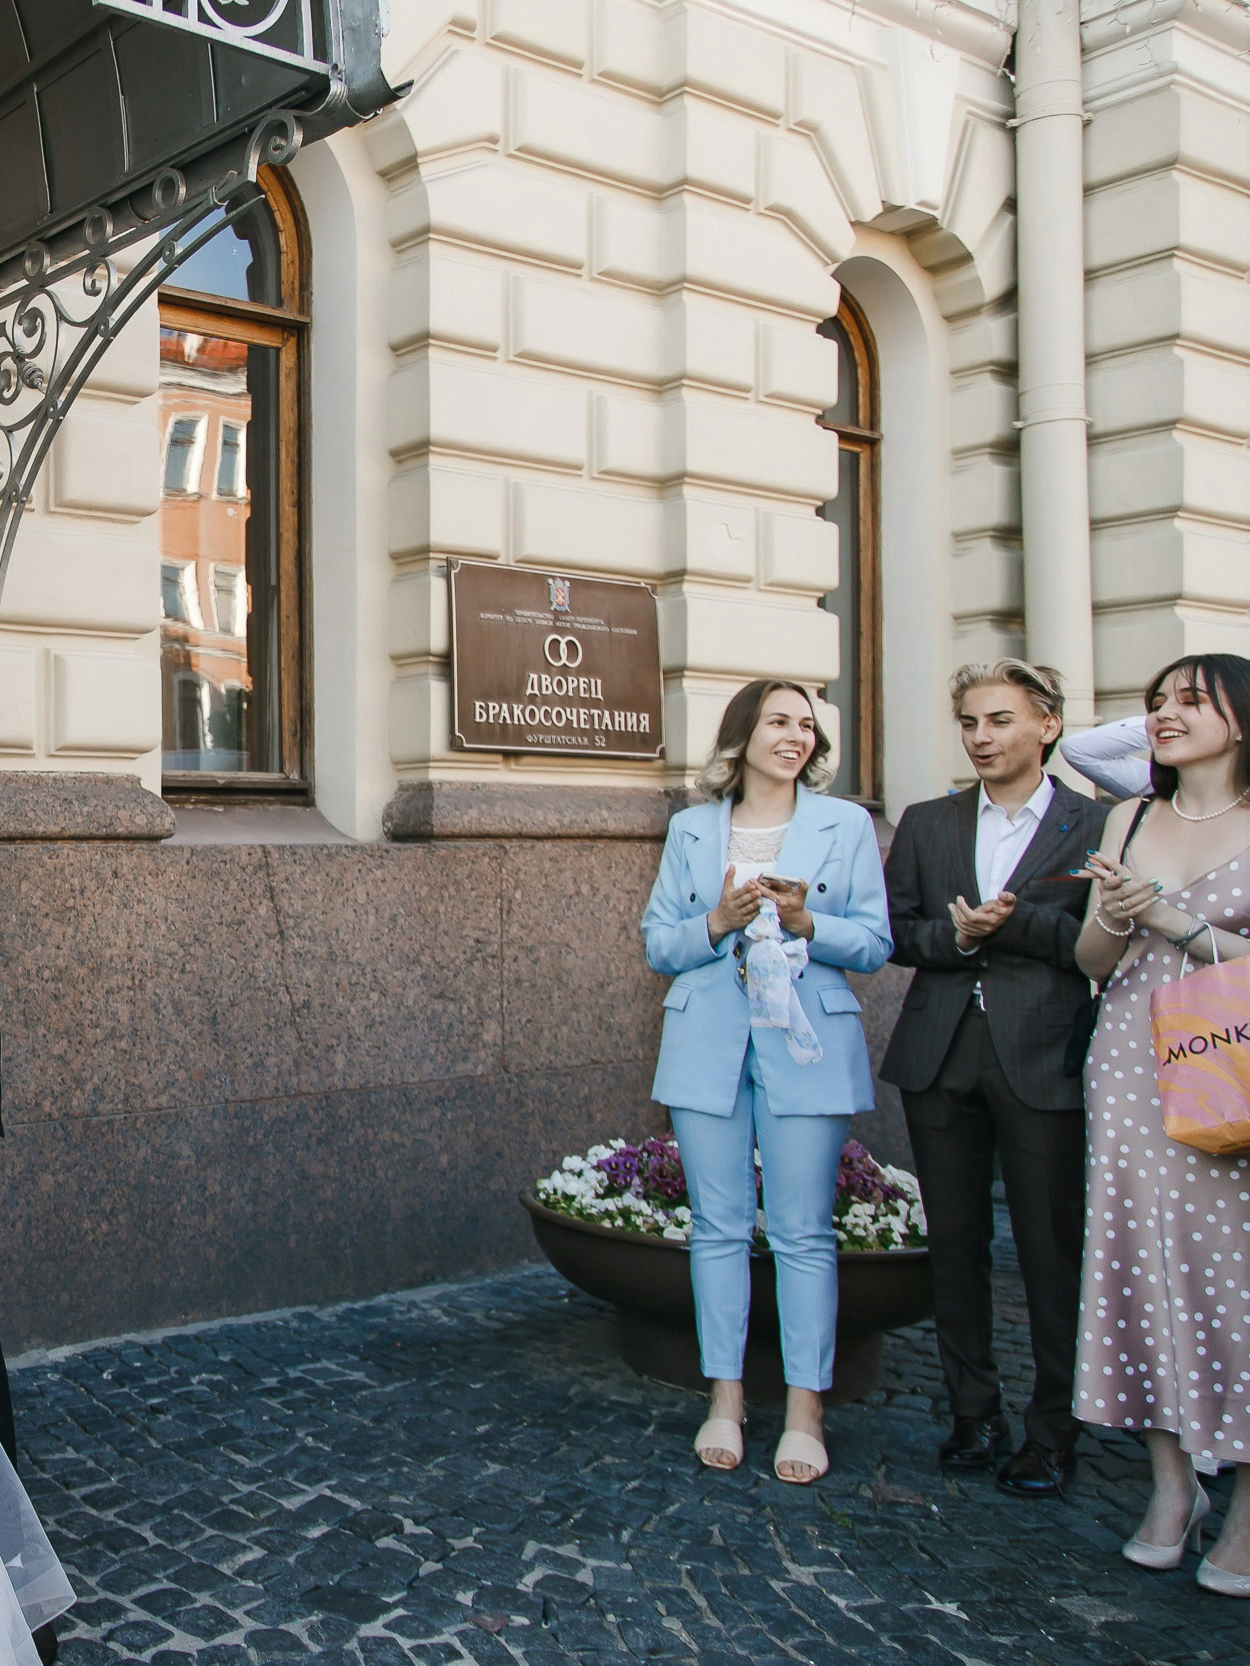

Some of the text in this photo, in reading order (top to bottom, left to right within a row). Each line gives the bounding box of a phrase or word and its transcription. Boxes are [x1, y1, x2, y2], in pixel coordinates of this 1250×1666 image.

[525, 673, 604, 700] ДВОРЕЦ
[473, 701, 651, 733] БРАКОСОЧЕТАНИЯ
[594, 735, 607, 748] 52
[1163, 1023, 1250, 1066] MONK
